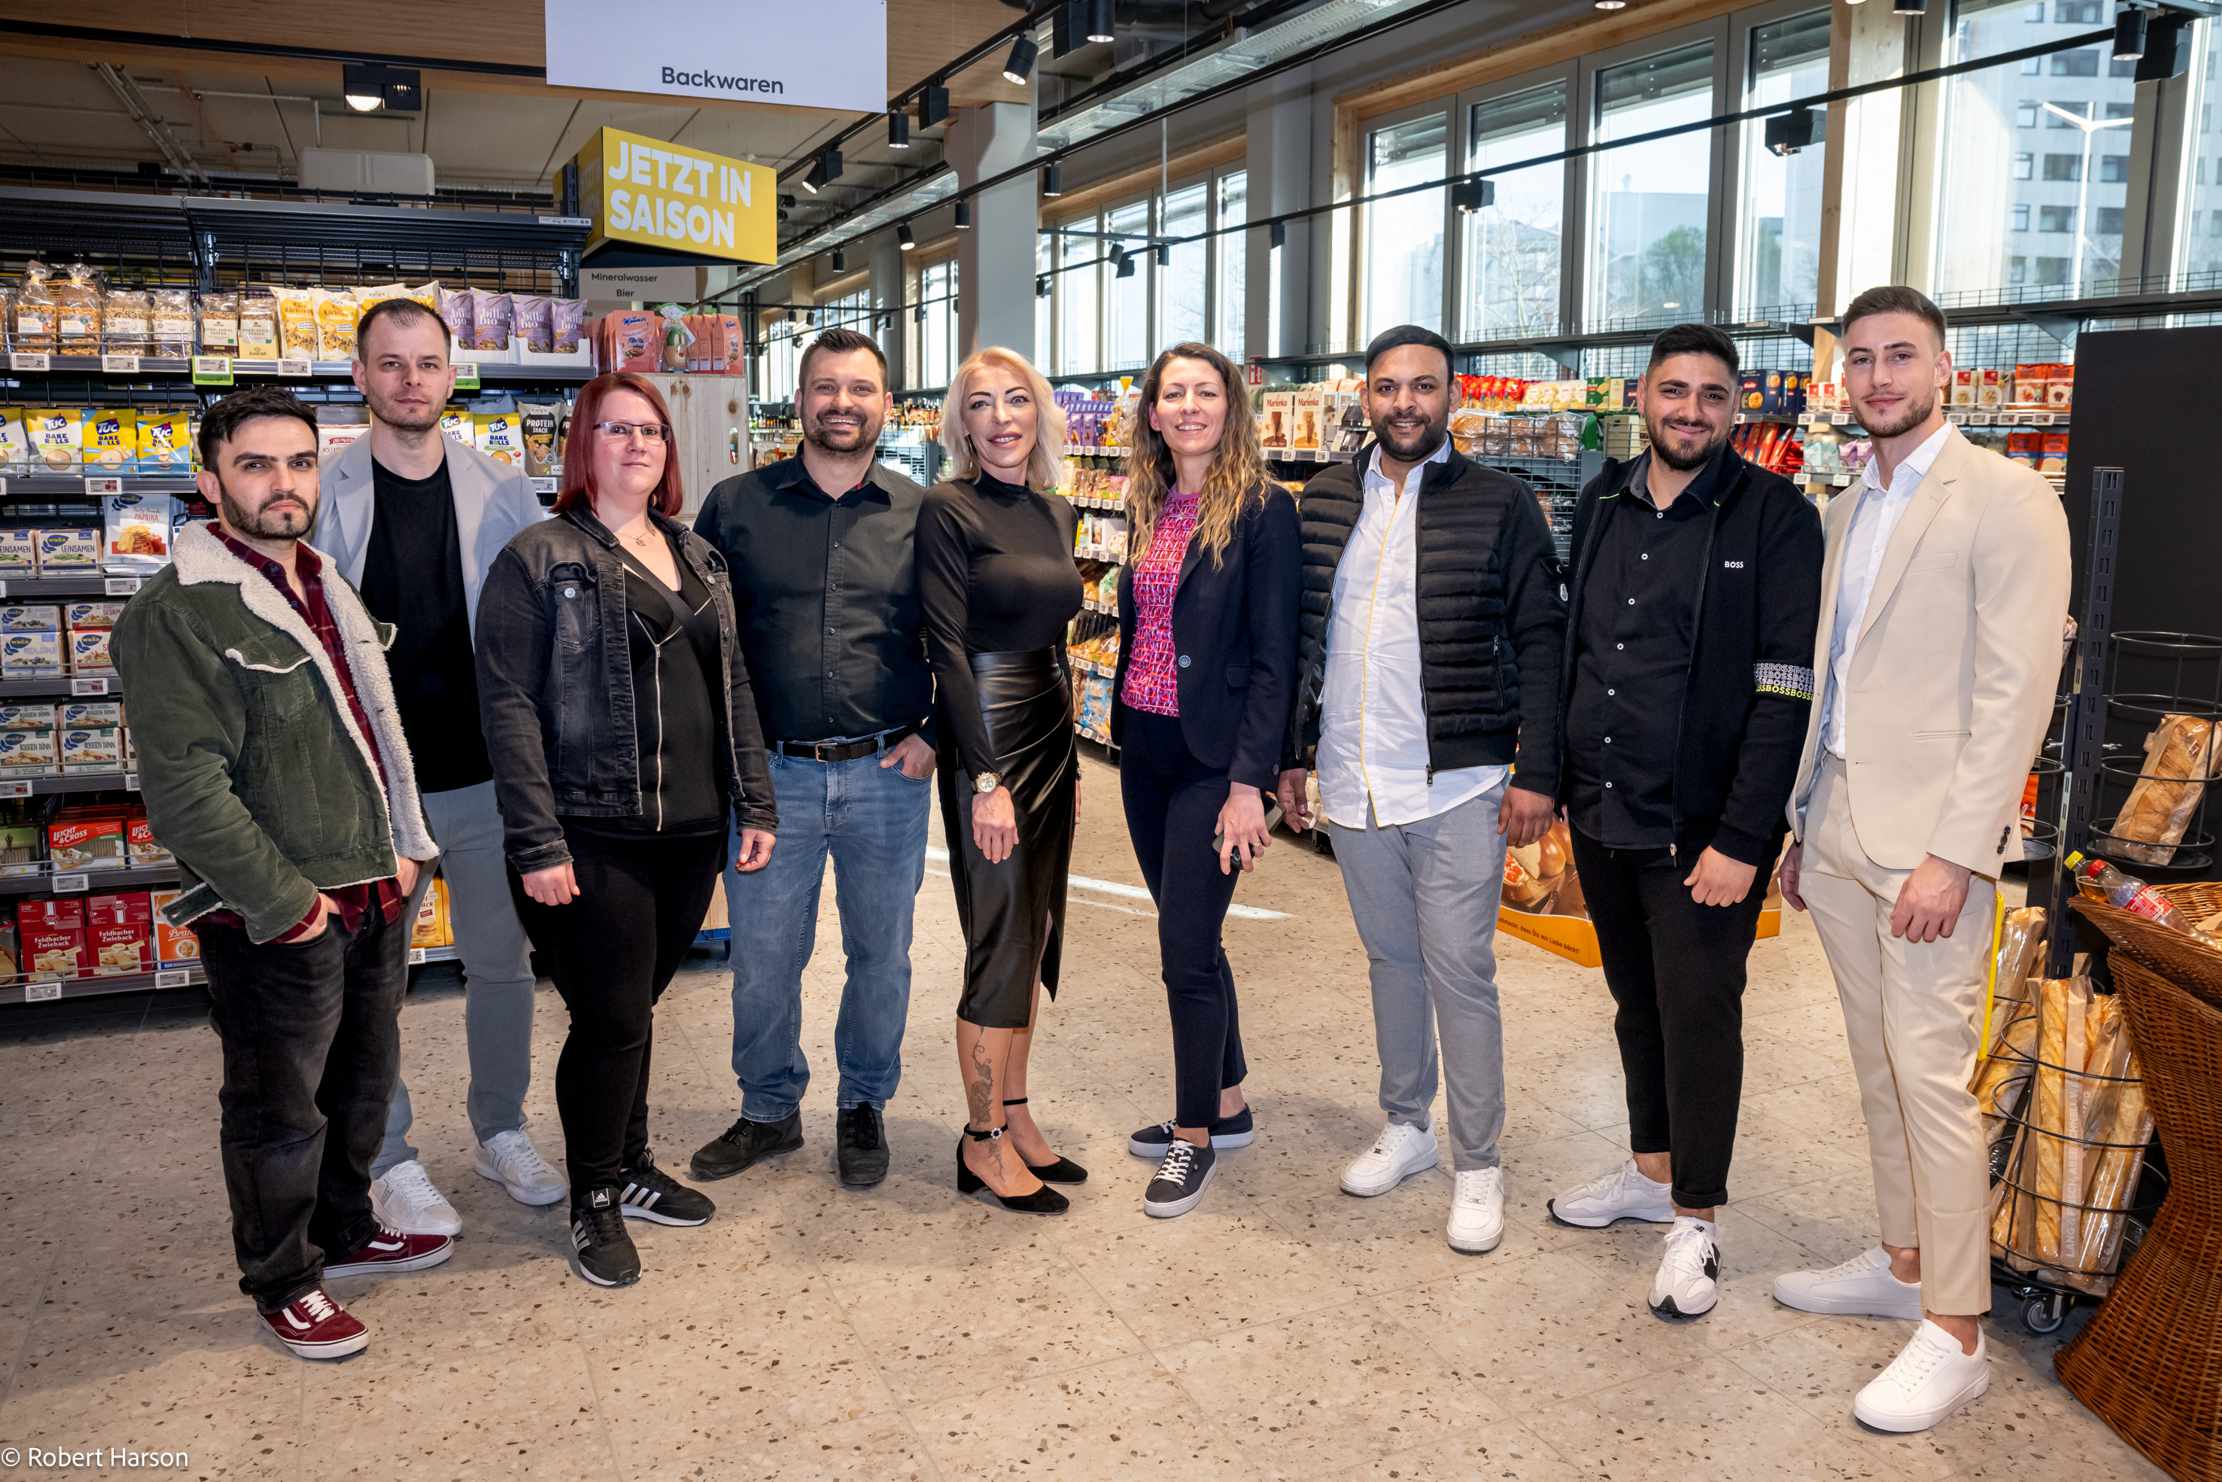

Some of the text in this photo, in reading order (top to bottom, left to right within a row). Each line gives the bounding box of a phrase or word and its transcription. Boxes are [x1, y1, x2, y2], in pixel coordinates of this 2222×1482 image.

[662, 66, 784, 94] Backwaren
[608, 141, 751, 208] JETZT IN
[609, 189, 735, 249] SAISON
[591, 272, 658, 283] Mineralwasser
[616, 289, 635, 297] Bier
[45, 418, 66, 430] TUC
[97, 422, 118, 433] TUC
[441, 418, 459, 428] TUC
[489, 422, 507, 432] TUC
[526, 419, 553, 427] PROTEIN
[61, 544, 95, 553] LEINSAMEN
[1724, 561, 1744, 569] BOSS
[53, 826, 77, 840] LEICHT
[99, 929, 134, 938] Feldbacher
[34, 935, 71, 944] Feldbacher
[102, 935, 132, 943] Zwieback
[38, 941, 70, 949] Zwieback
